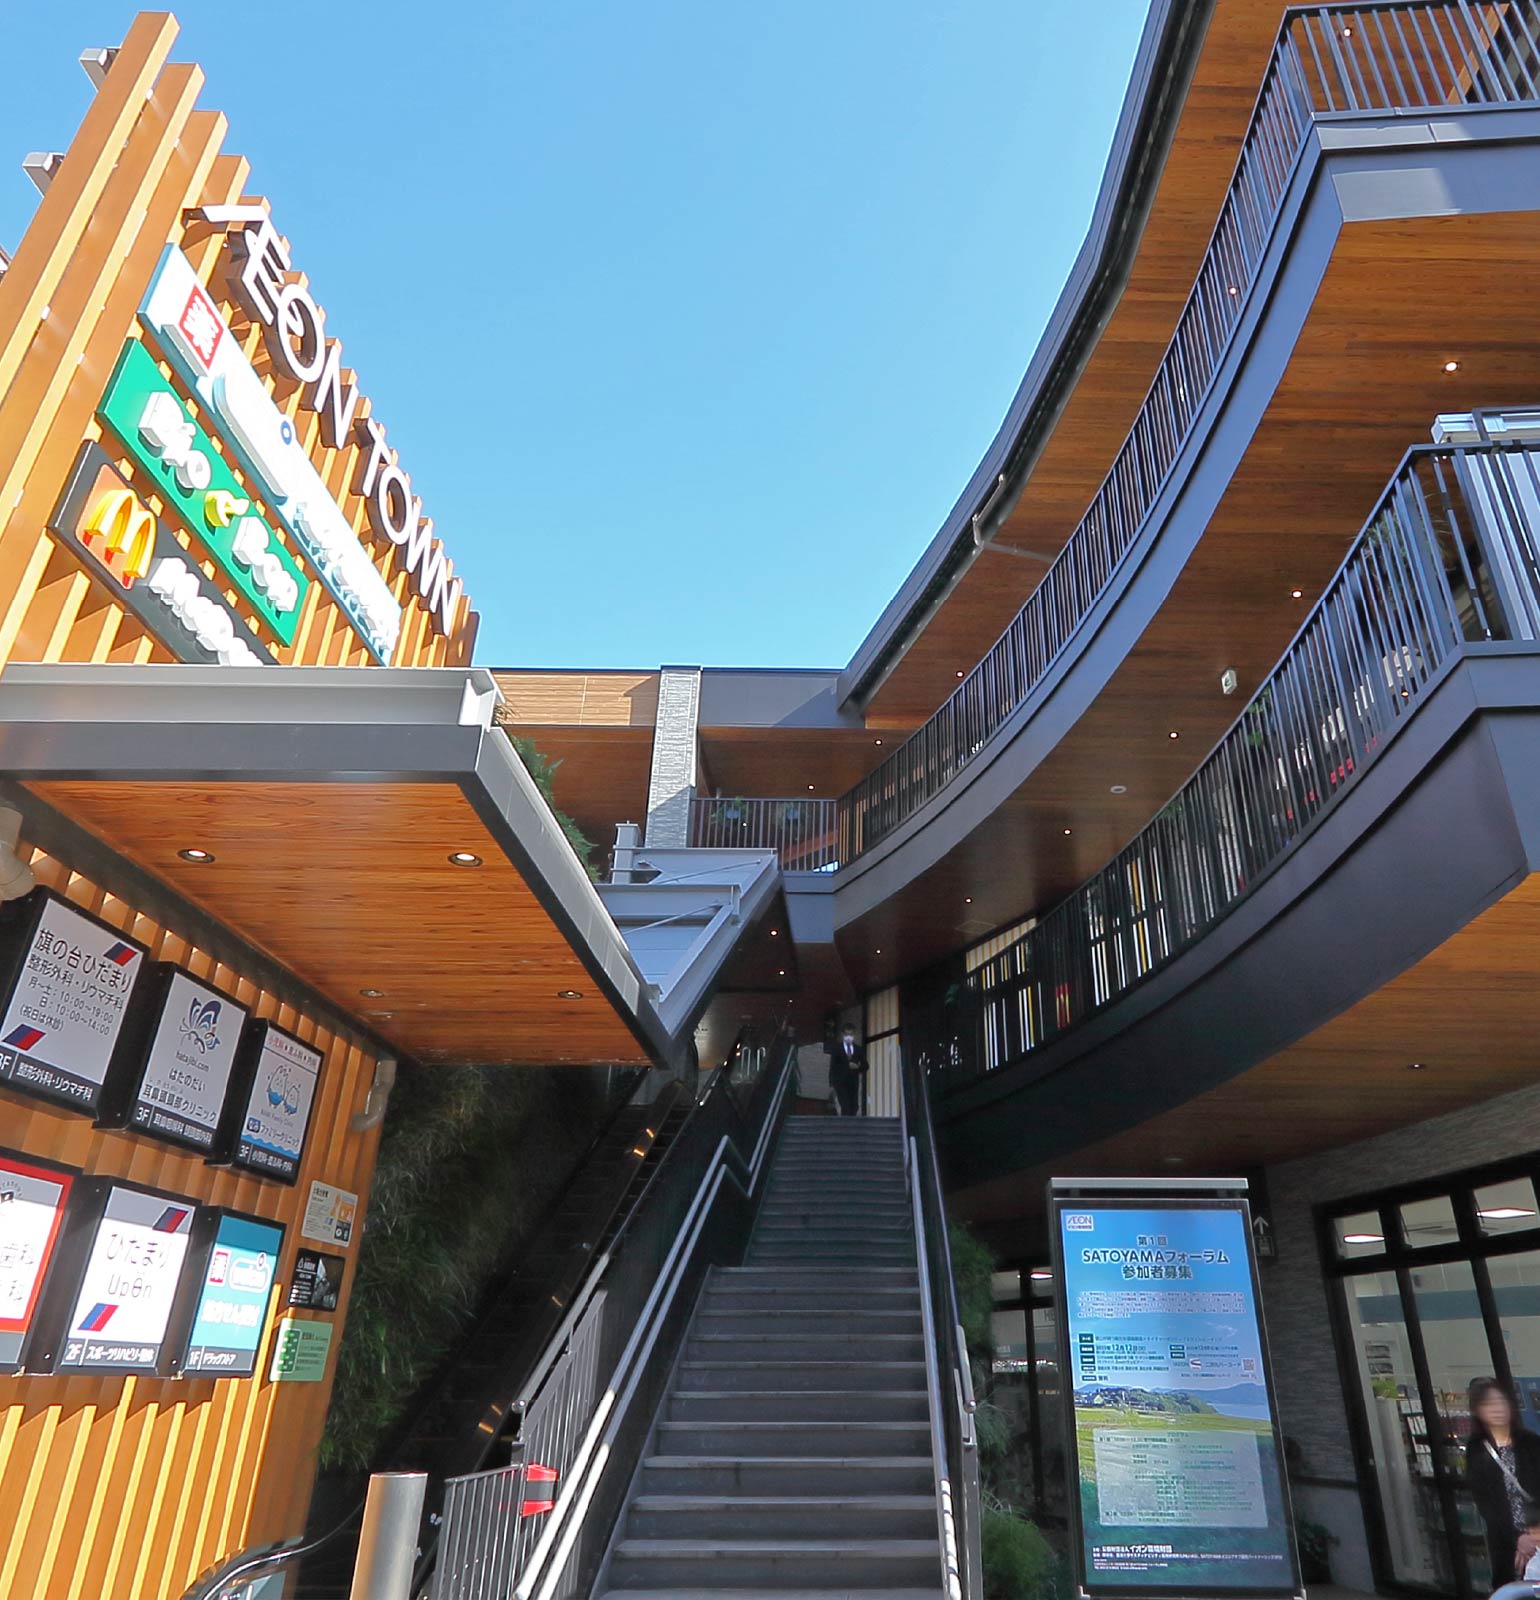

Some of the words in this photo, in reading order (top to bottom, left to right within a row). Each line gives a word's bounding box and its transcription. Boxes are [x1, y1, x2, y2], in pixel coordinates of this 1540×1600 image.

[363, 417, 460, 637] TOWN
[34, 927, 132, 993] 旗の台ひだまり
[28, 954, 123, 1012] 整形外科・リウマチ科
[168, 1068, 206, 1092] はたのだい
[135, 1107, 150, 1122] 3F
[240, 1145, 250, 1158] 3F
[1082, 1250, 1229, 1264] SATOYAMAフォーラム
[1122, 1266, 1192, 1279] 参加者募集
[66, 1343, 82, 1360] 2F
[189, 1351, 199, 1366] 1F
